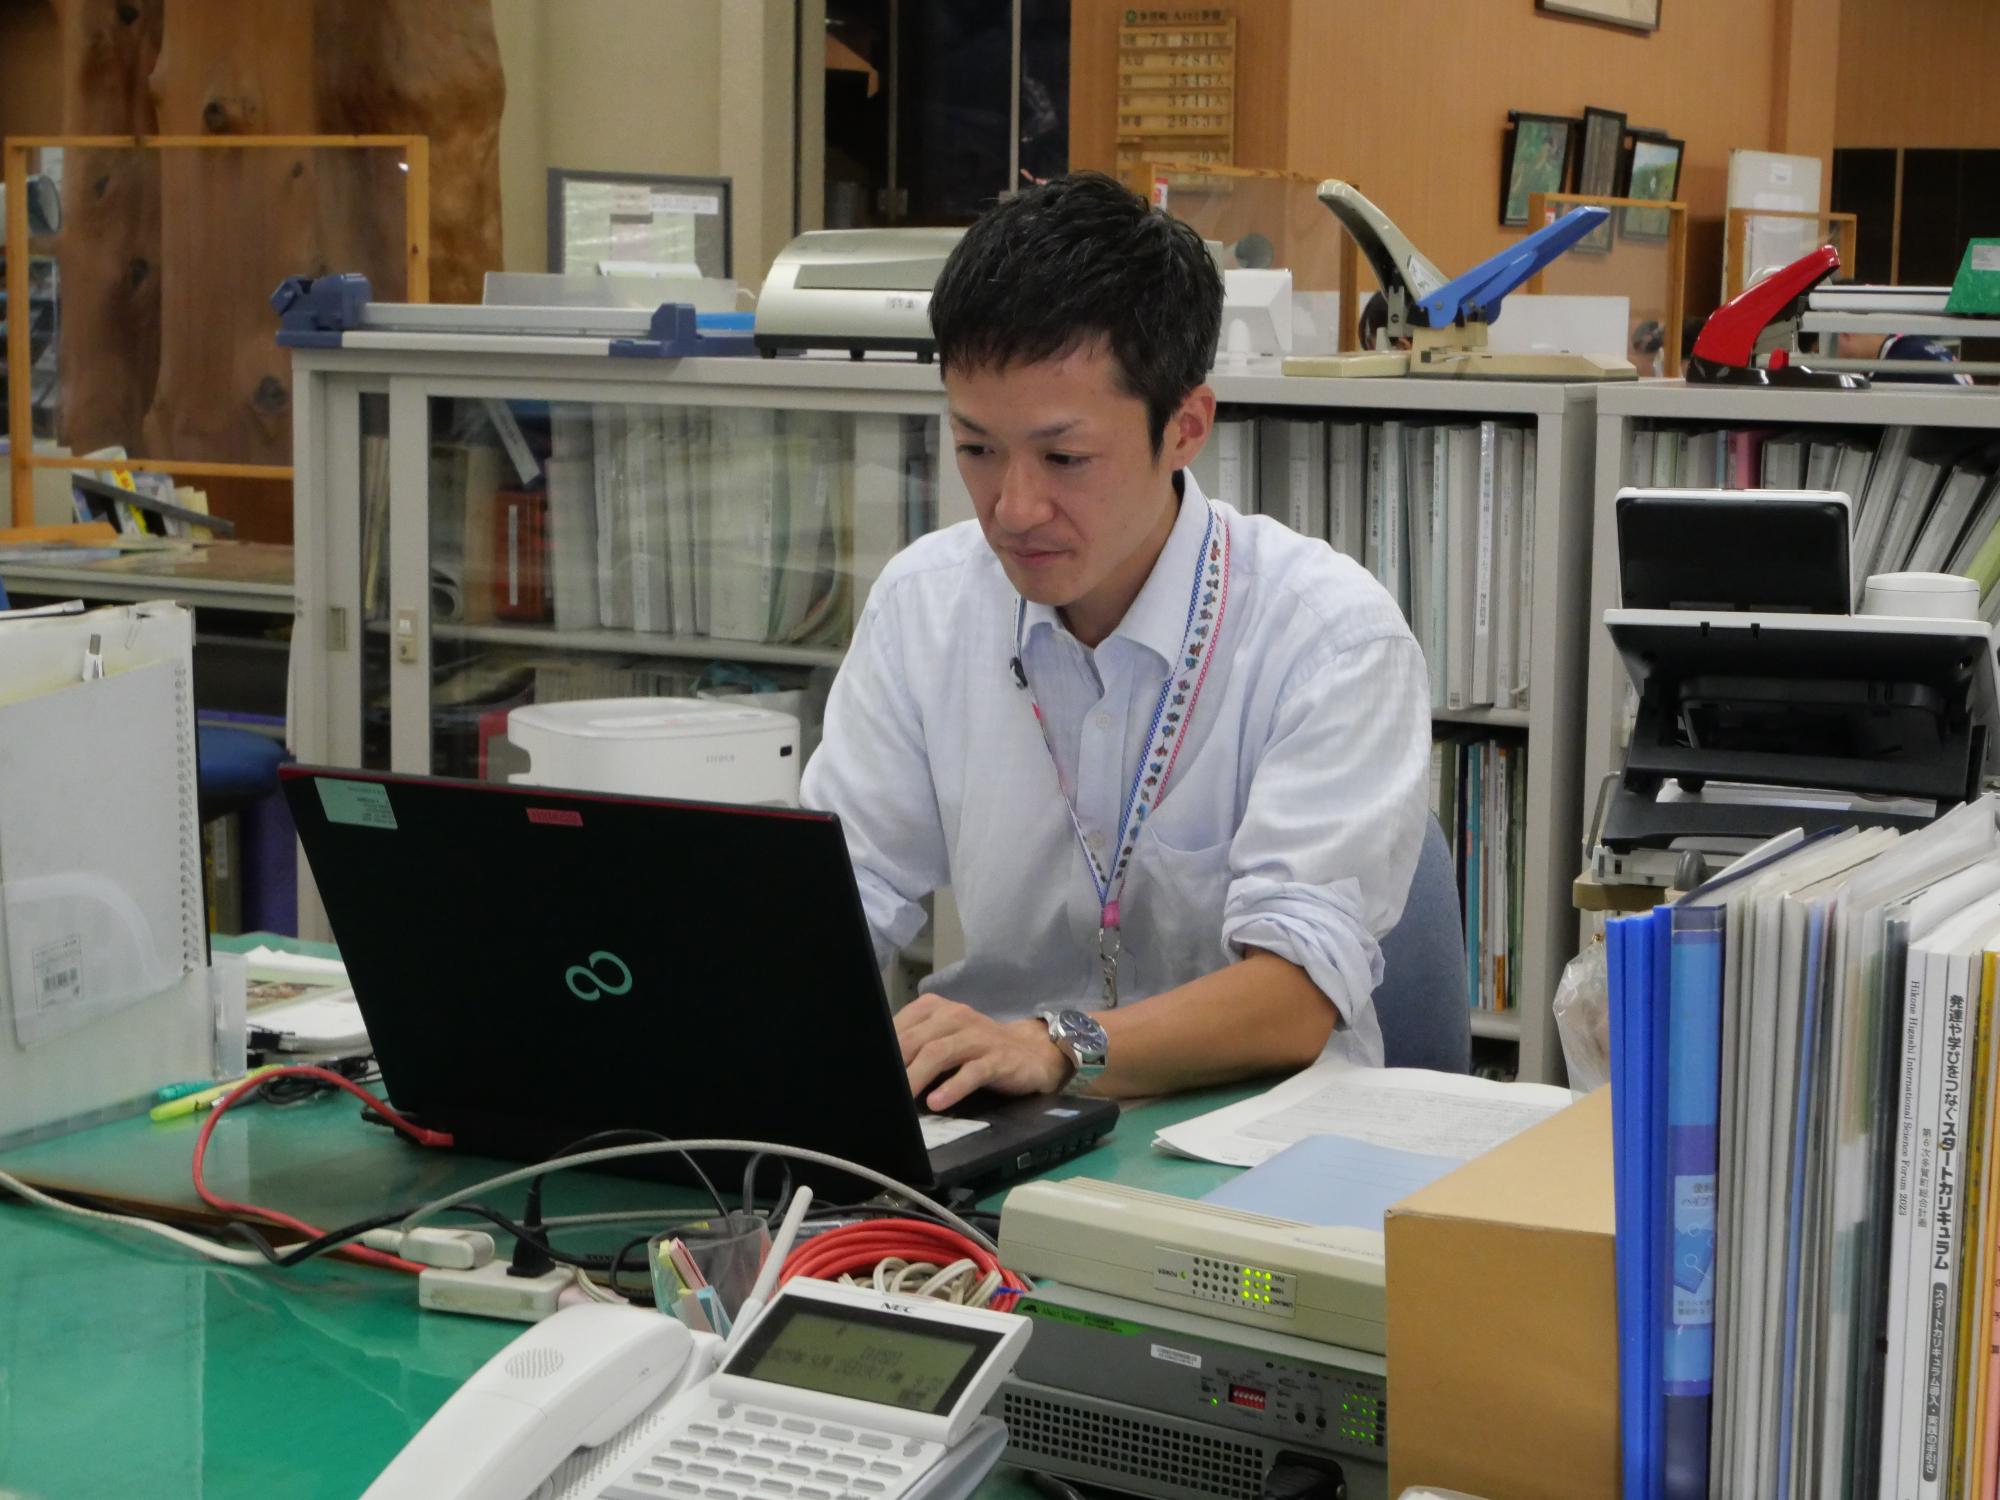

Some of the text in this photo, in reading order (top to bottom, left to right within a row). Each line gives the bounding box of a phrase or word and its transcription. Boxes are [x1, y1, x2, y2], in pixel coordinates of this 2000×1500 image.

[1909, 980, 1920, 1014] Hikone
[1906, 1017, 1918, 1054] Higashi
[1902, 1056, 1916, 1119] International
[1900, 1122, 1912, 1157] Science
[1933, 994, 1964, 1270] 発達や学びをつなぐスタートカリキュラム
[1899, 1160, 1910, 1191] Forum
[880, 1302, 914, 1314] NEC
